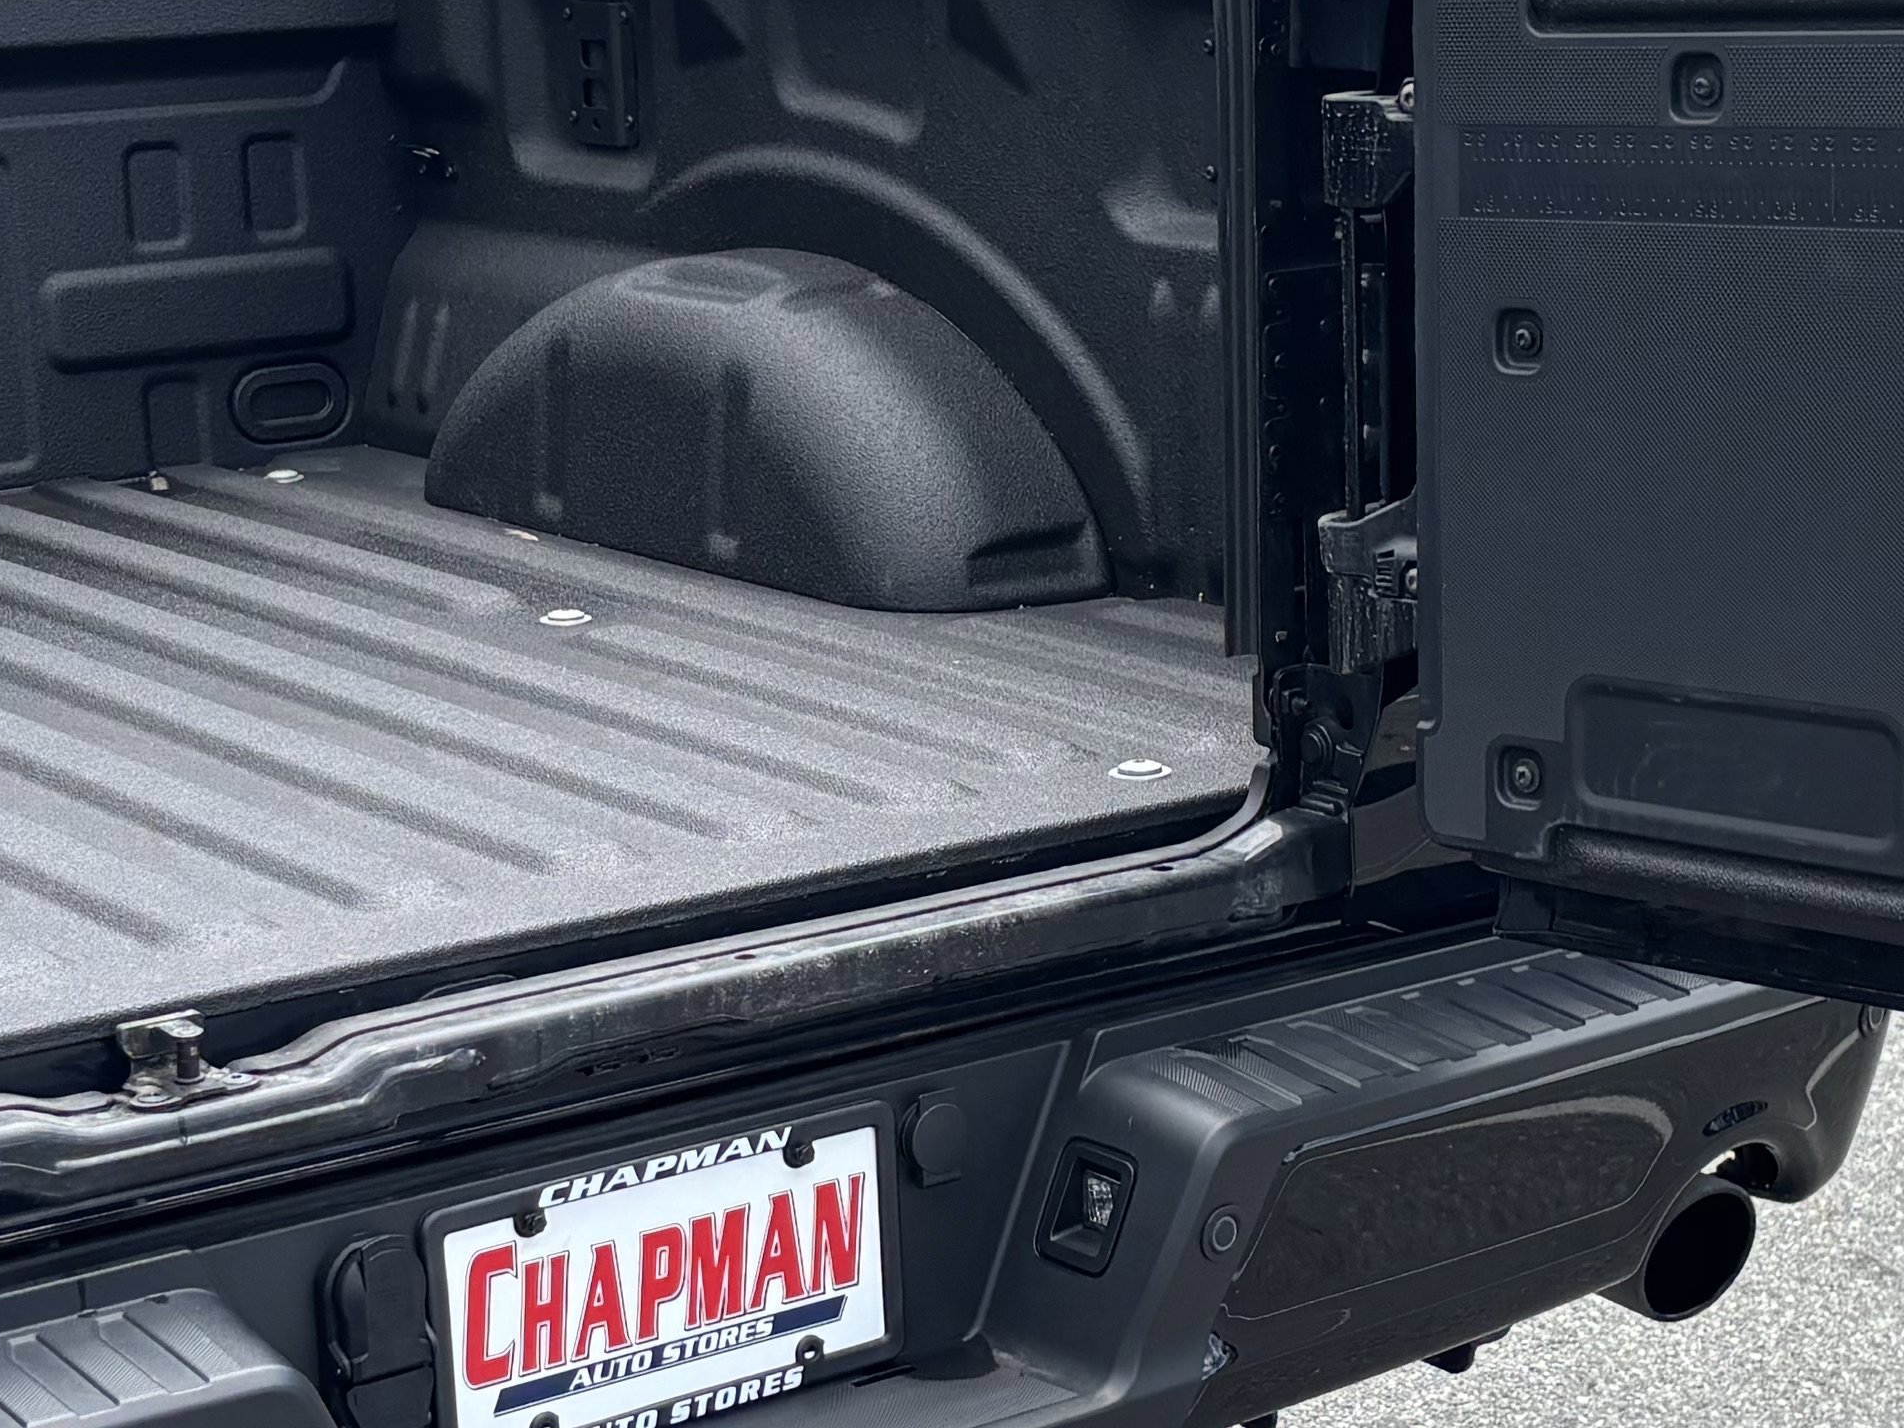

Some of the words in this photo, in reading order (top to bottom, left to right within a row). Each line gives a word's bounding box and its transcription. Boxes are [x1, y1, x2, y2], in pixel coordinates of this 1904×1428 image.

[538, 1126, 792, 1208] CHAPMAN
[463, 1173, 865, 1390] CHAPMAN
[568, 1347, 652, 1391] AUTO
[661, 1315, 775, 1364] STORES
[670, 1366, 804, 1424] STORES
